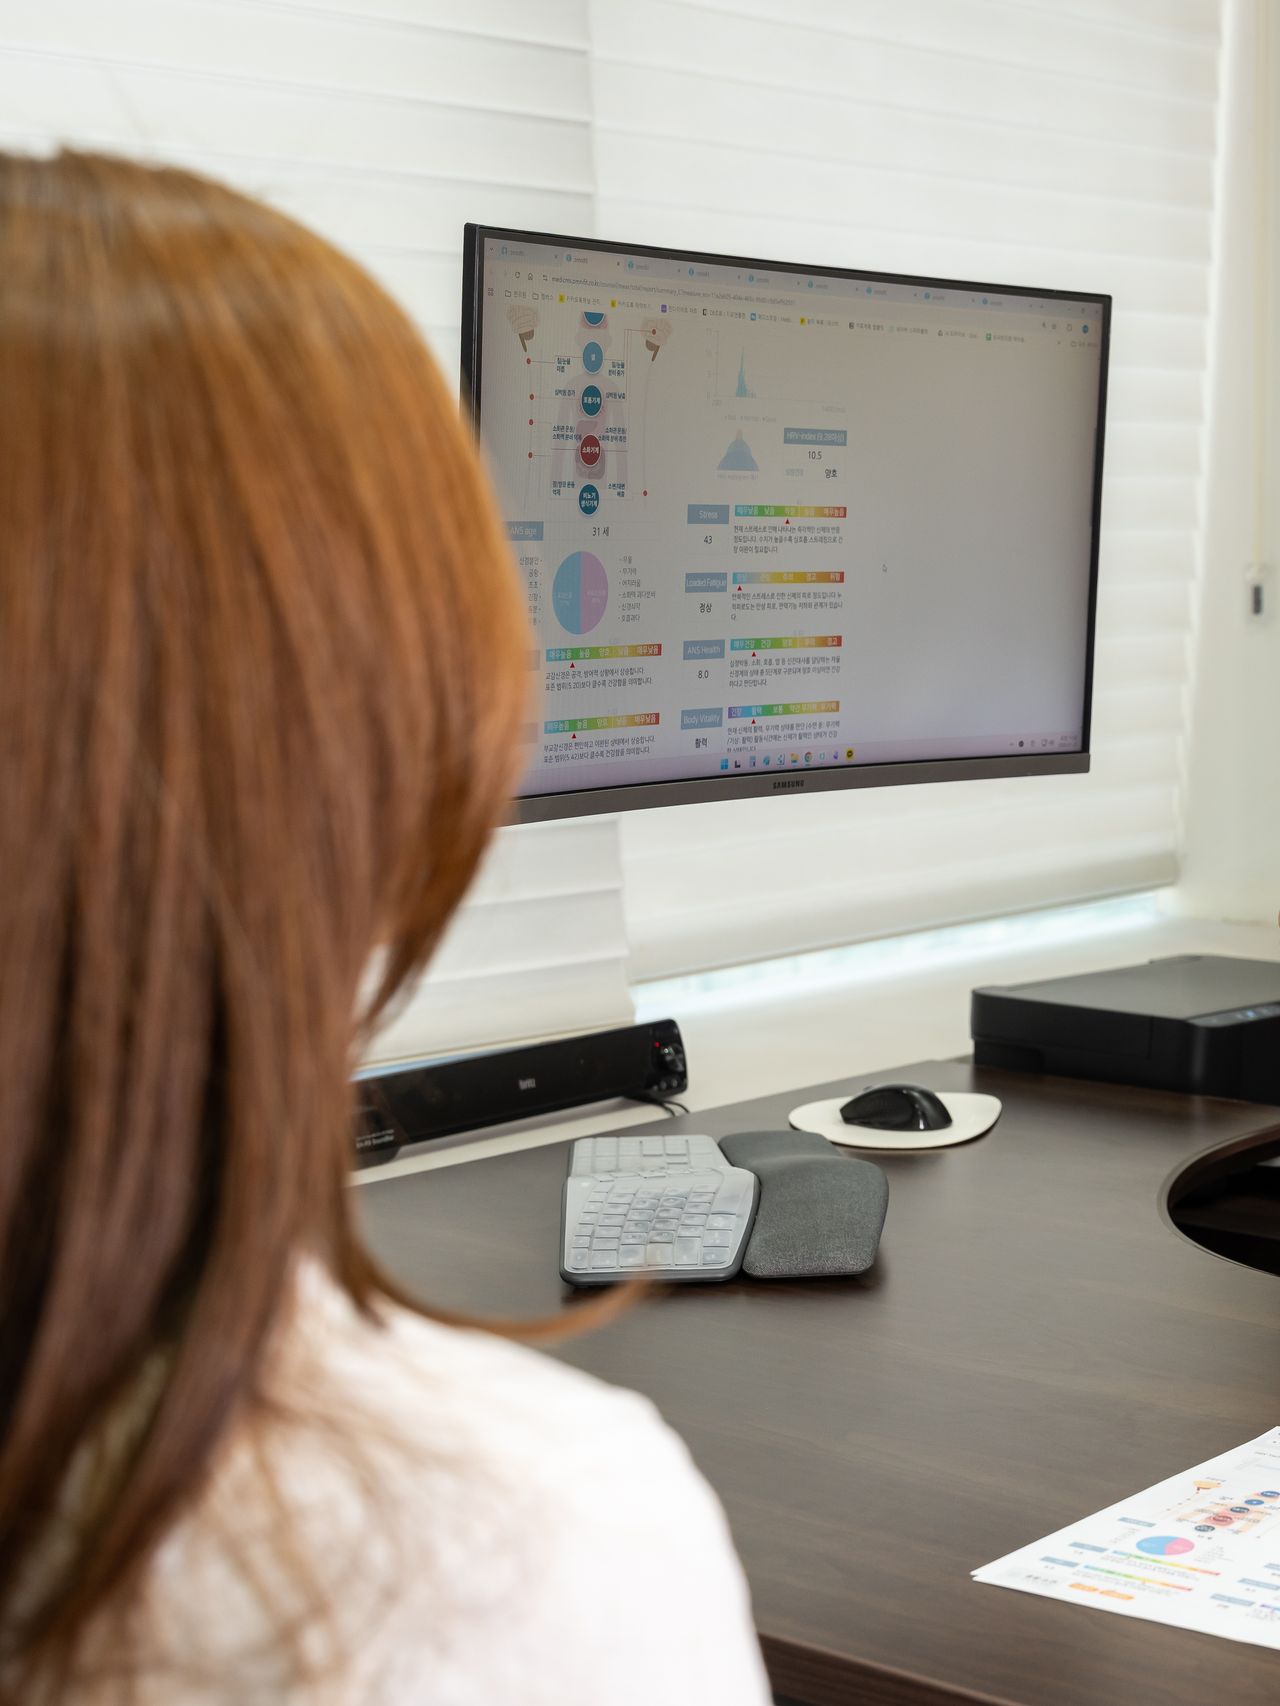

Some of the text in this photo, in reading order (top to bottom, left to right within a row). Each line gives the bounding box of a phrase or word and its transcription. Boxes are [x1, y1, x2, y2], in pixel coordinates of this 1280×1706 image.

[808, 450, 822, 460] 10.5
[824, 468, 838, 479] 양호
[592, 526, 609, 537] 31 세
[703, 535, 713, 544] 43
[621, 579, 641, 588] 어지러움
[752, 592, 775, 600] 스트레스로
[699, 603, 713, 613] 정상
[579, 649, 590, 658] 높음
[598, 648, 610, 657] 양호
[545, 671, 571, 680] 교감신경은
[583, 669, 599, 678] 방어적
[600, 668, 619, 677] 상황에서
[697, 669, 709, 679] 8.0
[592, 680, 607, 689] 클수록
[607, 679, 627, 688] 건강함을
[683, 711, 721, 725] Body Vitality
[578, 719, 588, 729] 높음
[544, 743, 574, 753] 부교감신경은
[610, 738, 630, 747] 상태에서
[695, 738, 708, 748] 활력
[590, 750, 605, 759] 클수록
[605, 749, 625, 758] 건강함을
[772, 780, 805, 790] SAMSUNG
